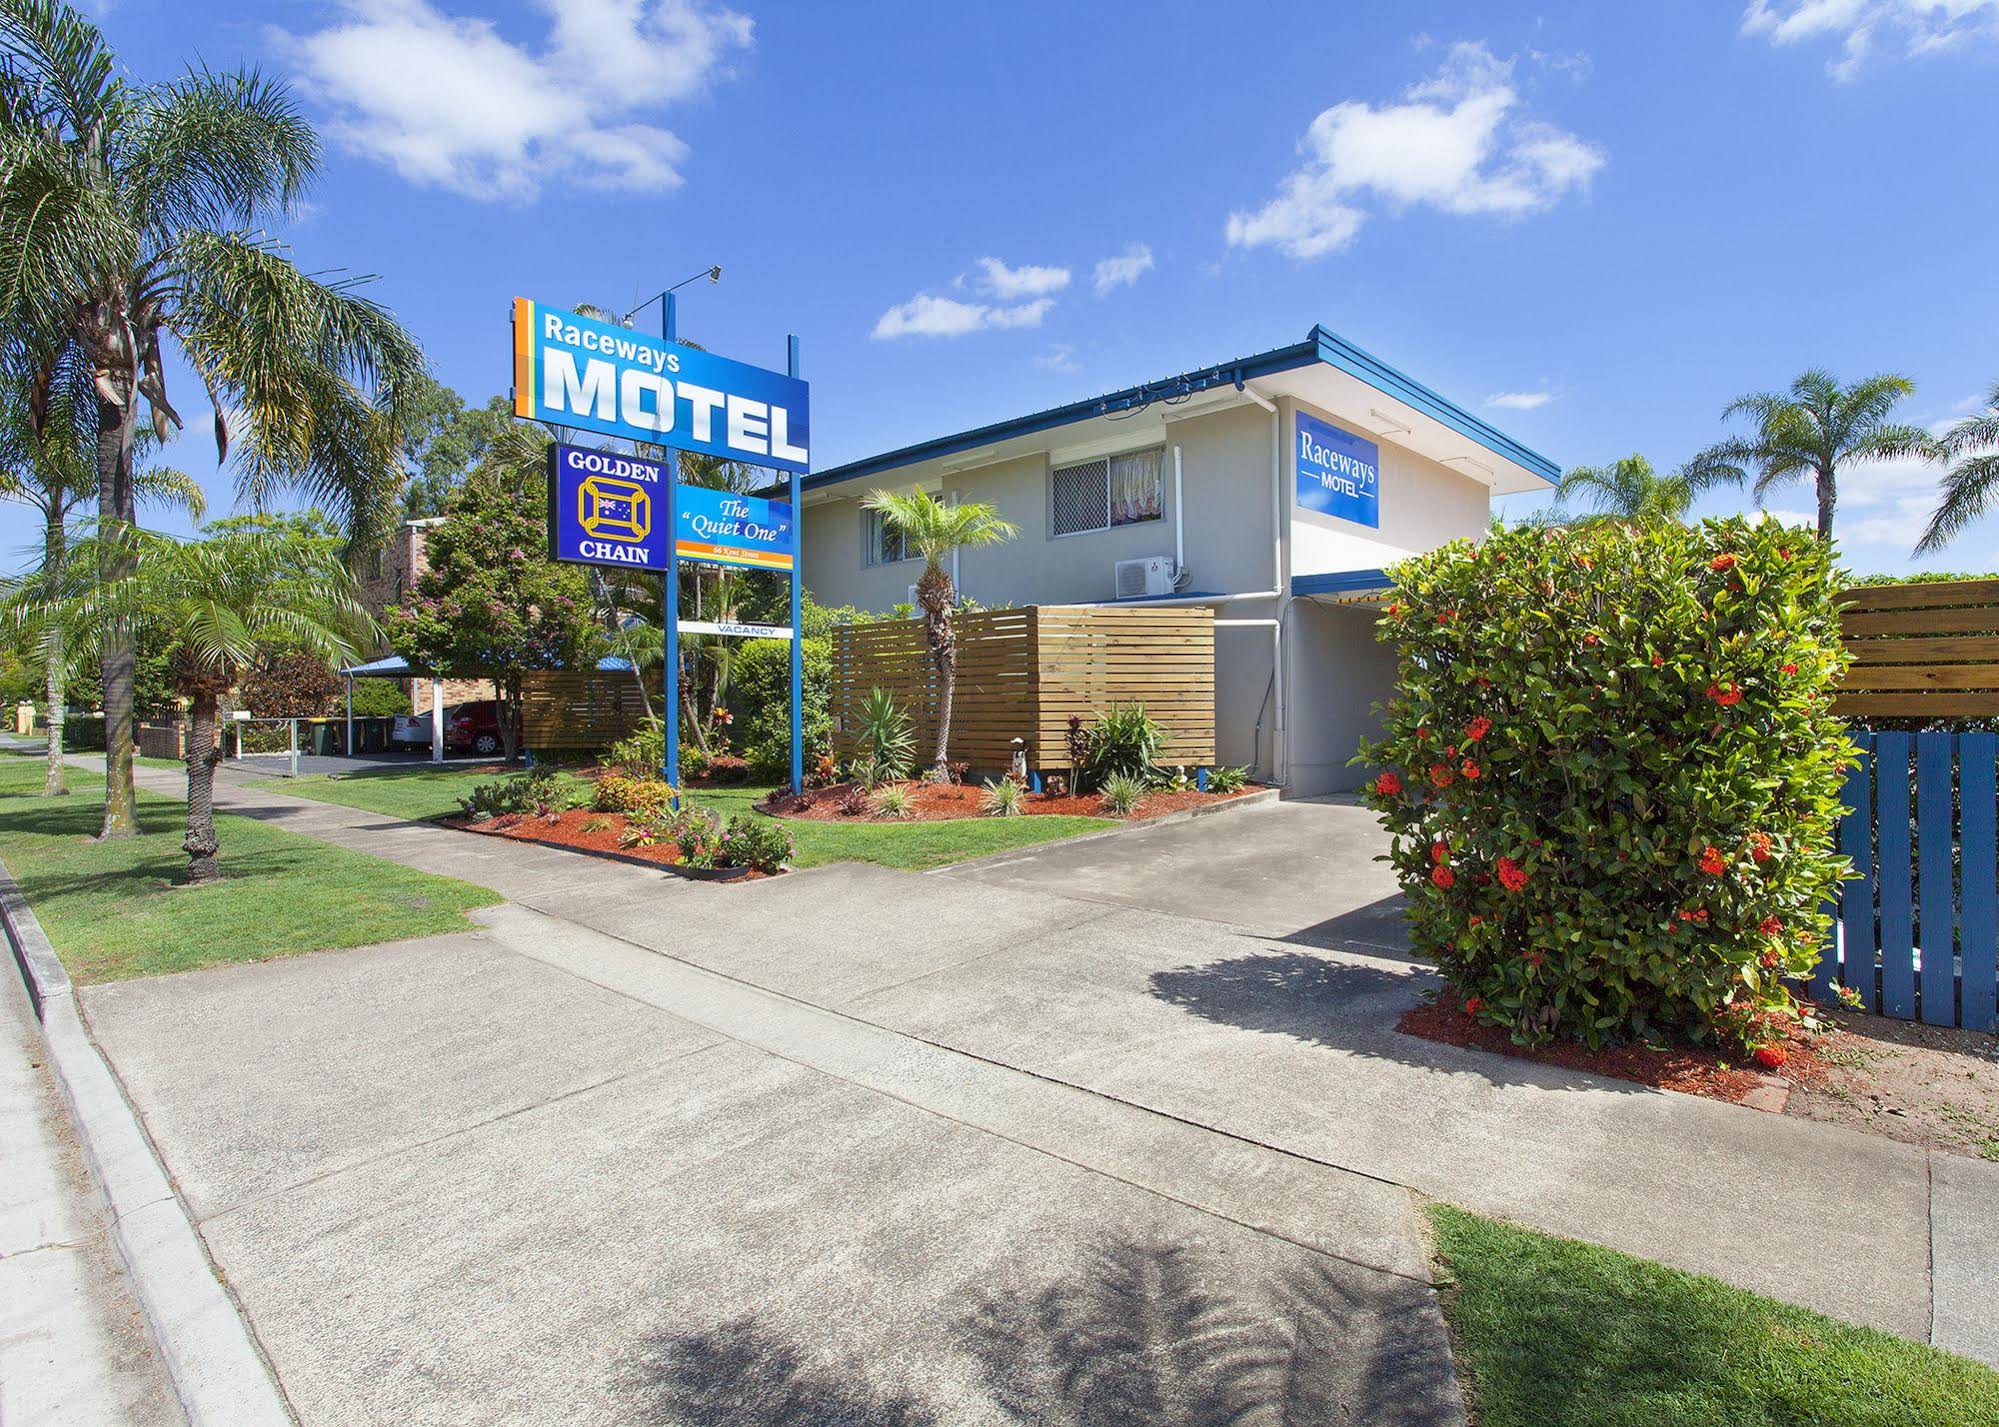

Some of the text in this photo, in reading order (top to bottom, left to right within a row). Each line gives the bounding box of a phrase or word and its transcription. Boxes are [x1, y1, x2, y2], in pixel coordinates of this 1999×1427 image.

[545, 313, 681, 373] Raceways
[543, 345, 808, 464] MOTEL
[567, 451, 659, 483] GOLDEN
[1300, 430, 1375, 488] Raceways
[1321, 471, 1359, 498] MOTEL
[719, 500, 750, 518] The
[579, 540, 649, 565] CHAIN
[718, 624, 776, 635] VACANCY
